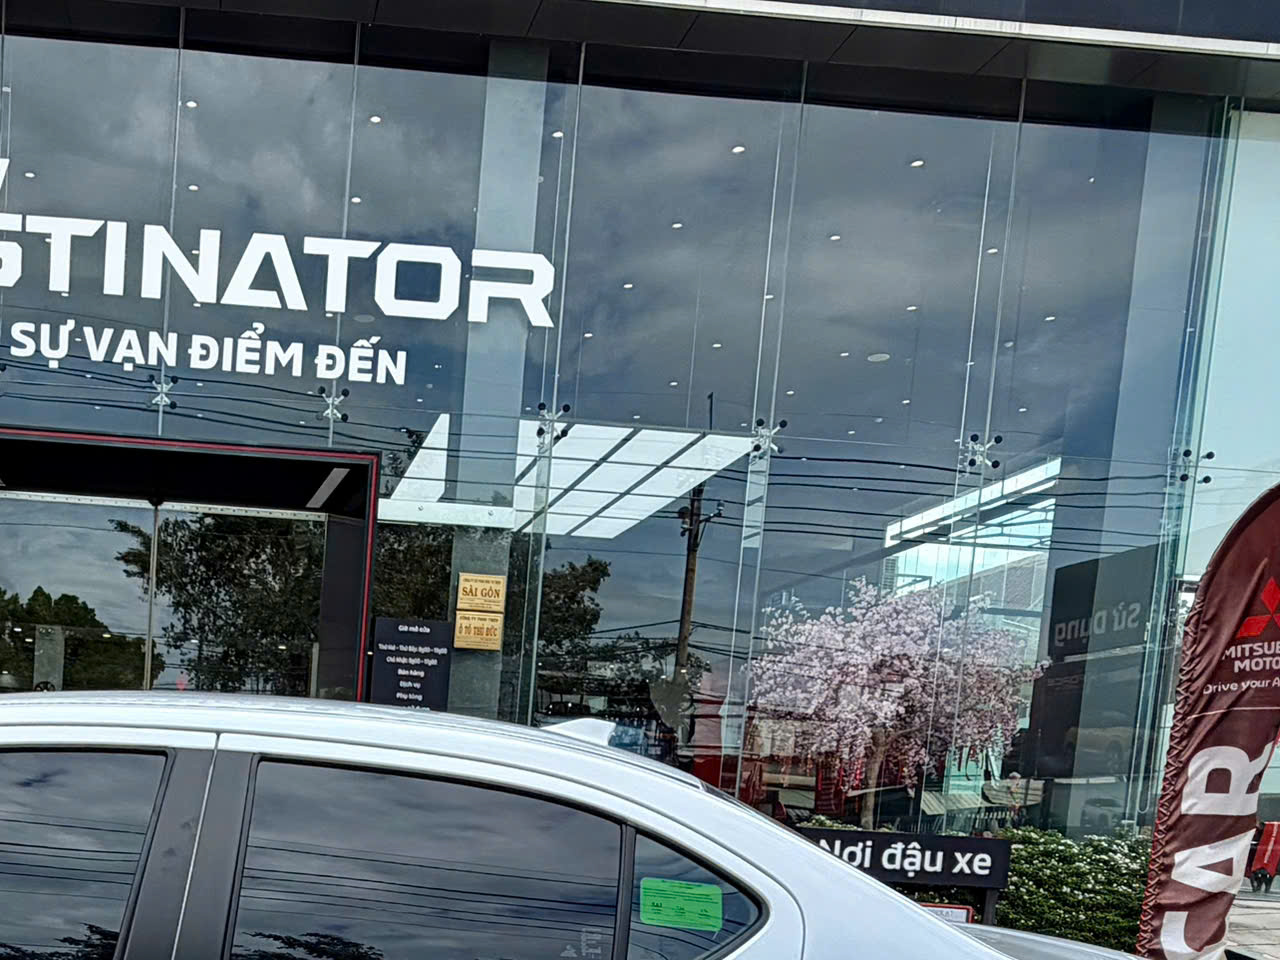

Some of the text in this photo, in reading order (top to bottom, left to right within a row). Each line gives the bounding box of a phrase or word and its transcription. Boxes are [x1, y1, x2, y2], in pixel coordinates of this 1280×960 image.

[10, 316, 74, 370] SỰ
[82, 328, 177, 375] VẠN
[188, 323, 304, 377] ĐIỂM
[315, 336, 408, 385] ĐẾN
[462, 584, 478, 597] SÀI
[1203, 681, 1239, 695] Drive
[1241, 679, 1271, 692] your
[881, 841, 944, 879] đậu
[951, 851, 993, 875] xe
